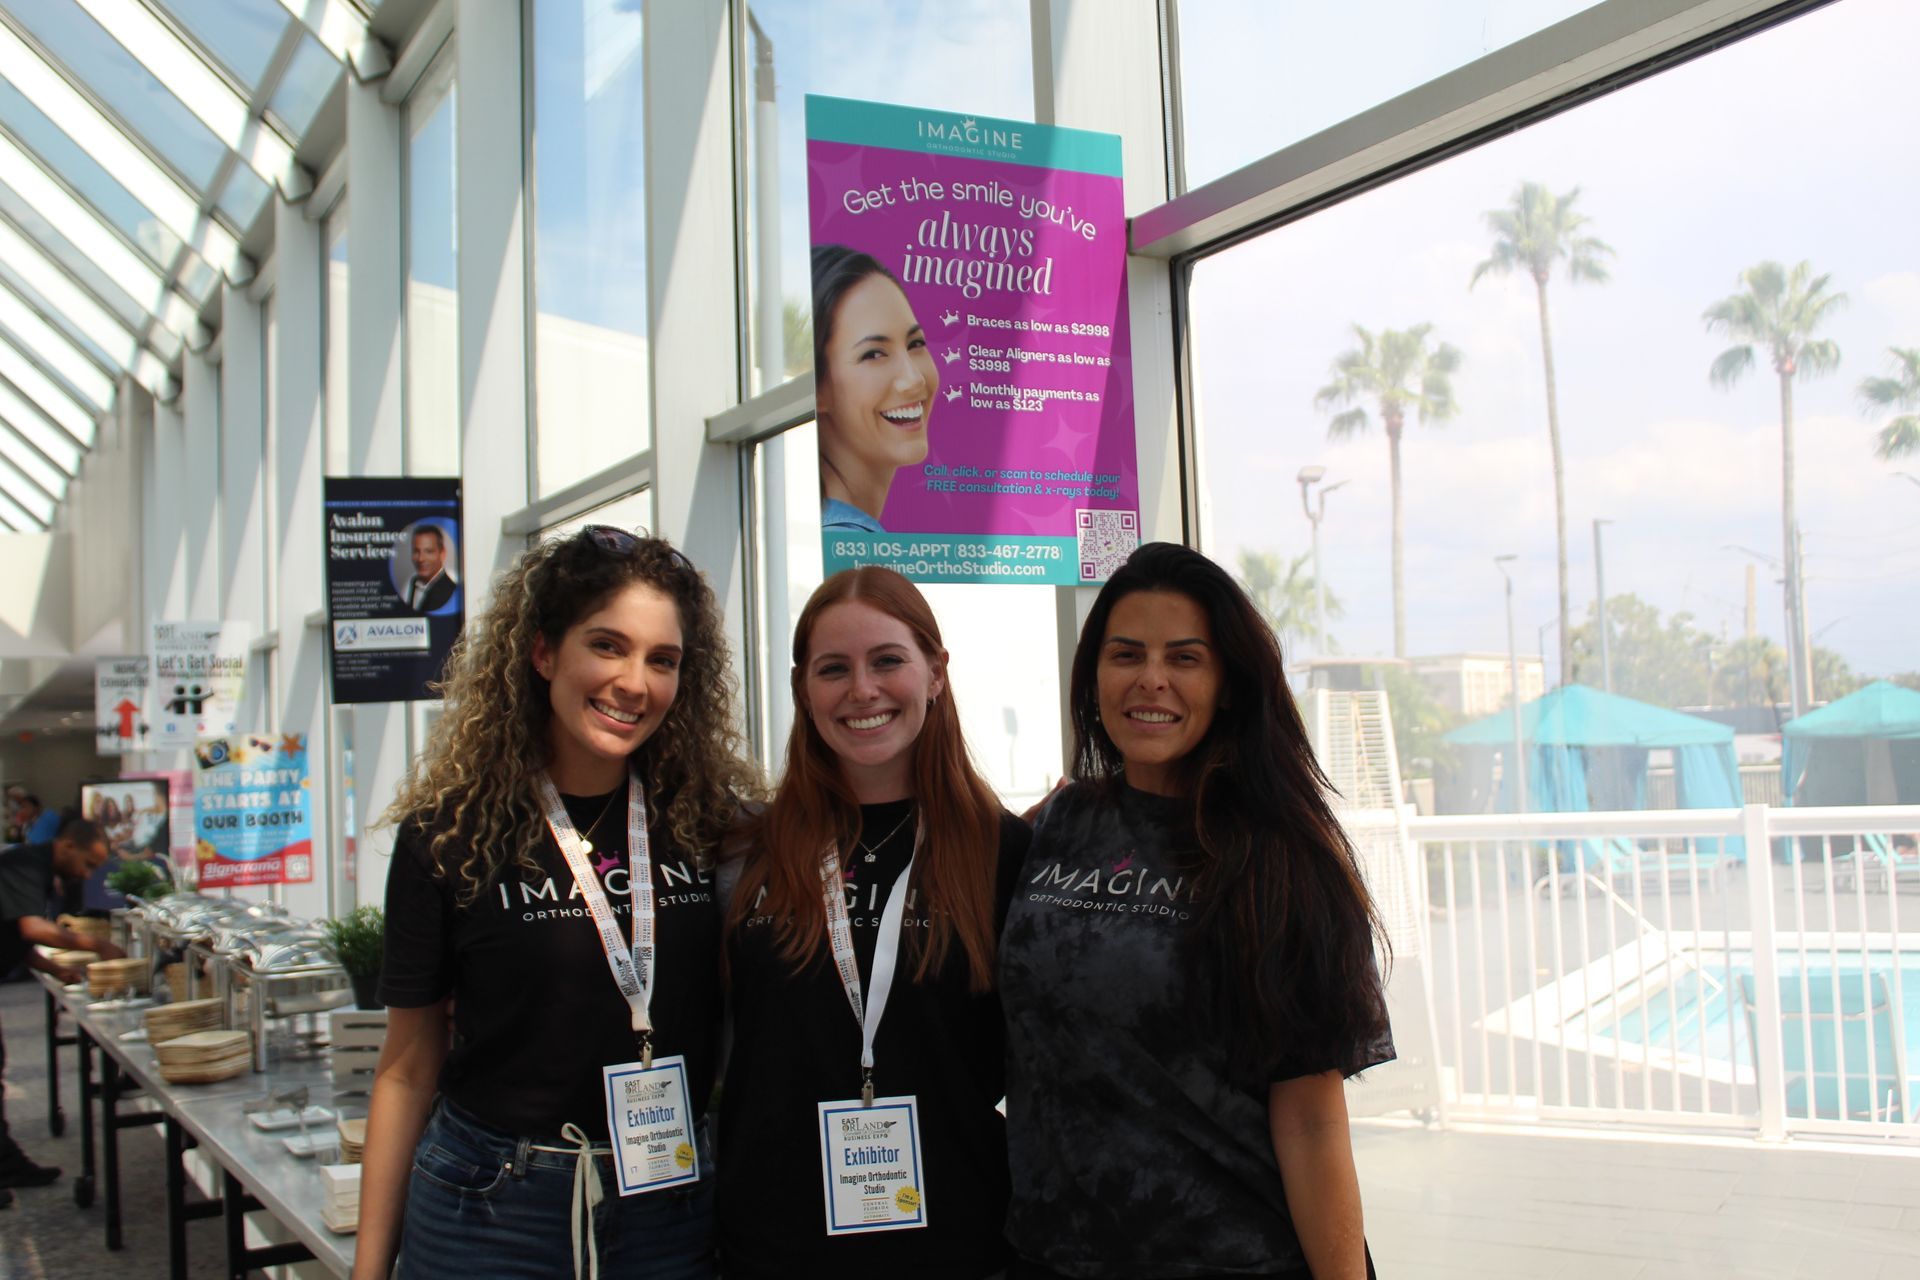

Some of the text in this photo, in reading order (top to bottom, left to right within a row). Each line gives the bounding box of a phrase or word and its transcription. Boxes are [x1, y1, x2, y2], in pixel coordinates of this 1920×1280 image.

[918, 120, 1023, 149] IMAGINE
[926, 142, 1017, 160] ORTHODONTIC STUDIO
[843, 176, 1097, 241] Get the smile you've
[918, 210, 1034, 262] always
[902, 244, 1055, 299] imagined
[967, 314, 1110, 337] Braces as low as $2998
[968, 344, 1111, 367] Clear Aligners as low as
[969, 358, 1010, 372] $3998
[970, 382, 1100, 402] Monthly payments as
[971, 396, 1044, 412] low as $123
[984, 468, 999, 478] or
[1000, 469, 1028, 480] scan
[1030, 469, 1043, 480] to
[1044, 470, 1093, 482] schedule
[1095, 474, 1121, 486] your
[926, 480, 1120, 500] FREE consultation & x-rays today!
[329, 511, 384, 528] Avalon
[330, 528, 408, 544] Insurance
[330, 543, 396, 559] Services
[831, 541, 1063, 562] (833) IOS-APPT (833-467-2778)
[367, 624, 424, 636] AVALON
[209, 653, 243, 669] Social
[201, 768, 301, 788] THE PARTY
[202, 791, 272, 811] STARTS
[278, 789, 302, 806] AT
[203, 810, 304, 830] OUR BOOTH
[203, 858, 281, 877] Signarama
[1029, 893, 1190, 921] ORTHODONTIC STUDIO
[627, 1105, 675, 1128] Exhibitor
[841, 1117, 859, 1125] EAST
[625, 1127, 683, 1146] Imagine Orthodontic
[647, 1142, 667, 1154] Studio
[844, 1146, 900, 1167] Exhibitor
[840, 1170, 907, 1185] Imagine Orthodontic
[864, 1184, 886, 1195] Studio
